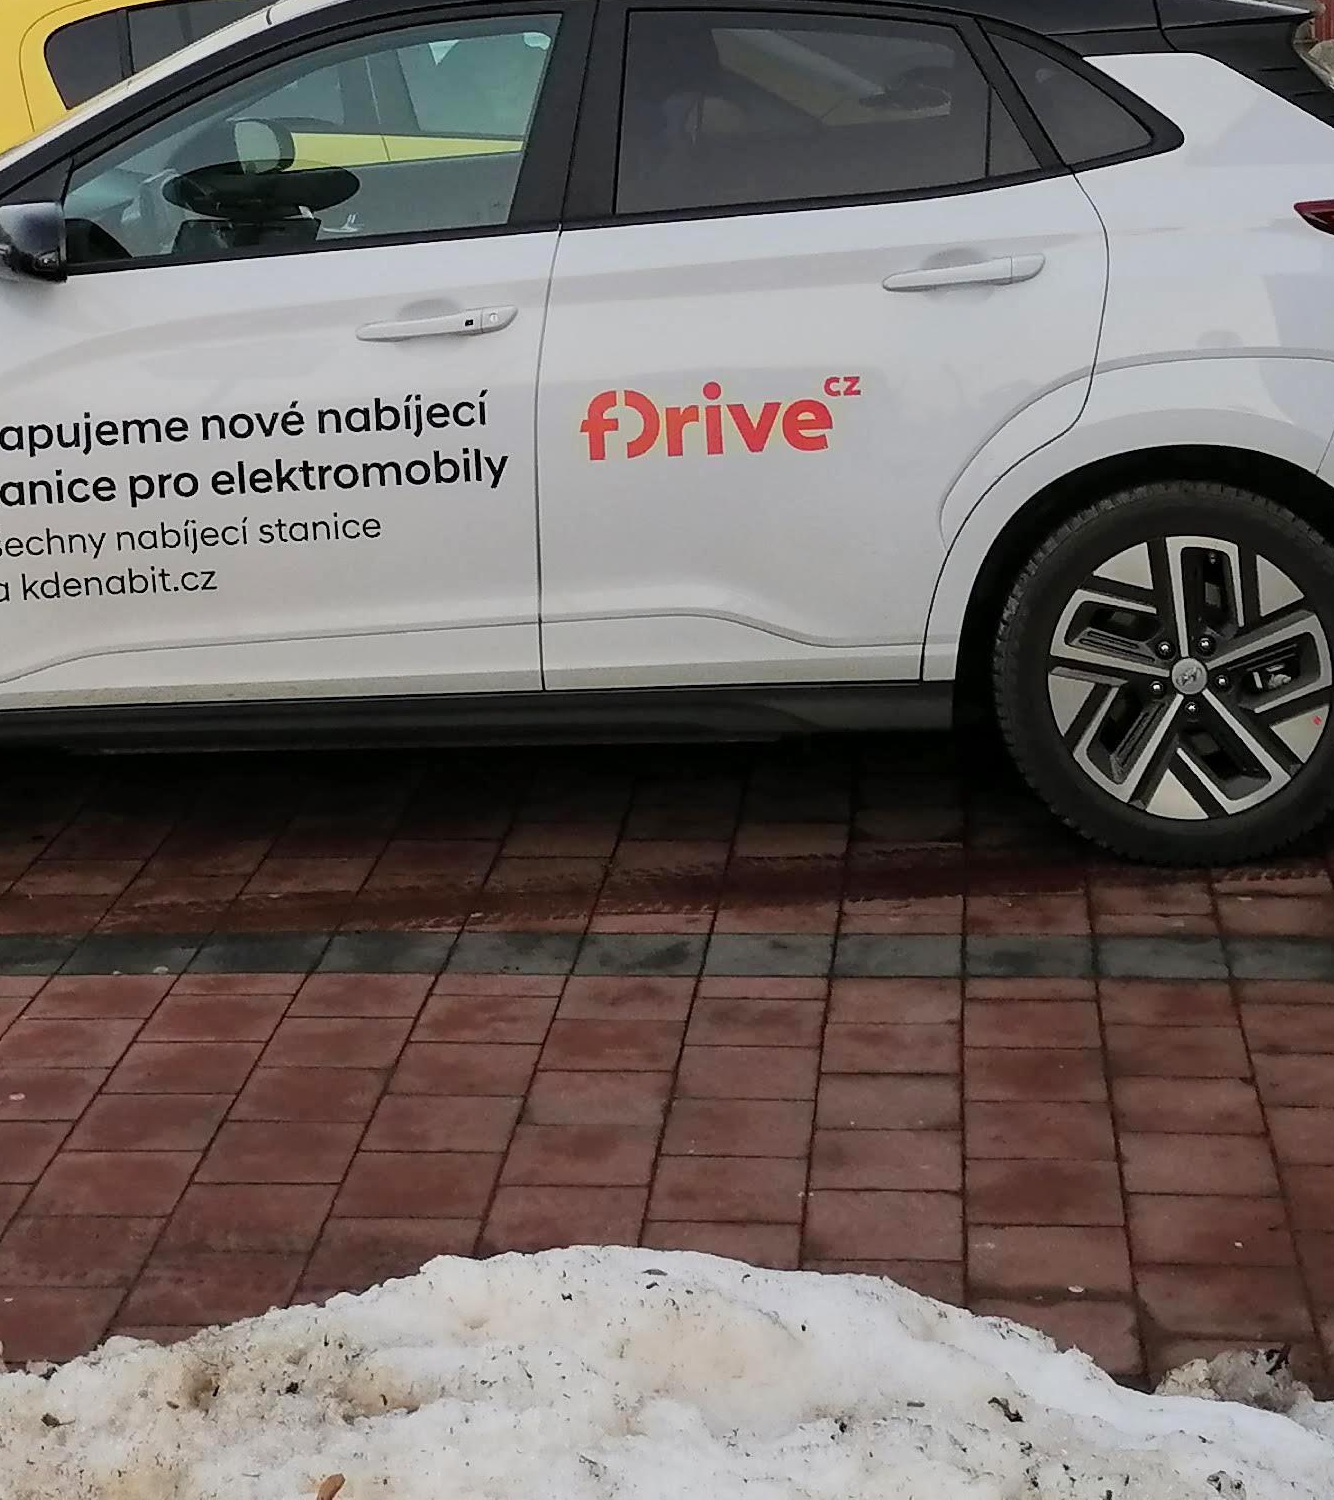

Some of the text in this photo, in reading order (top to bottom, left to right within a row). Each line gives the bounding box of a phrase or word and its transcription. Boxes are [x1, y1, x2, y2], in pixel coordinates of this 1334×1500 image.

[202, 401, 305, 440] nové
[318, 389, 489, 438] nabíjecí
[130, 470, 198, 507] pro
[211, 448, 509, 496] elektromobily
[117, 516, 249, 553] nabíjecí
[259, 512, 382, 543] stanice
[21, 565, 218, 601] kdenabit.cz
